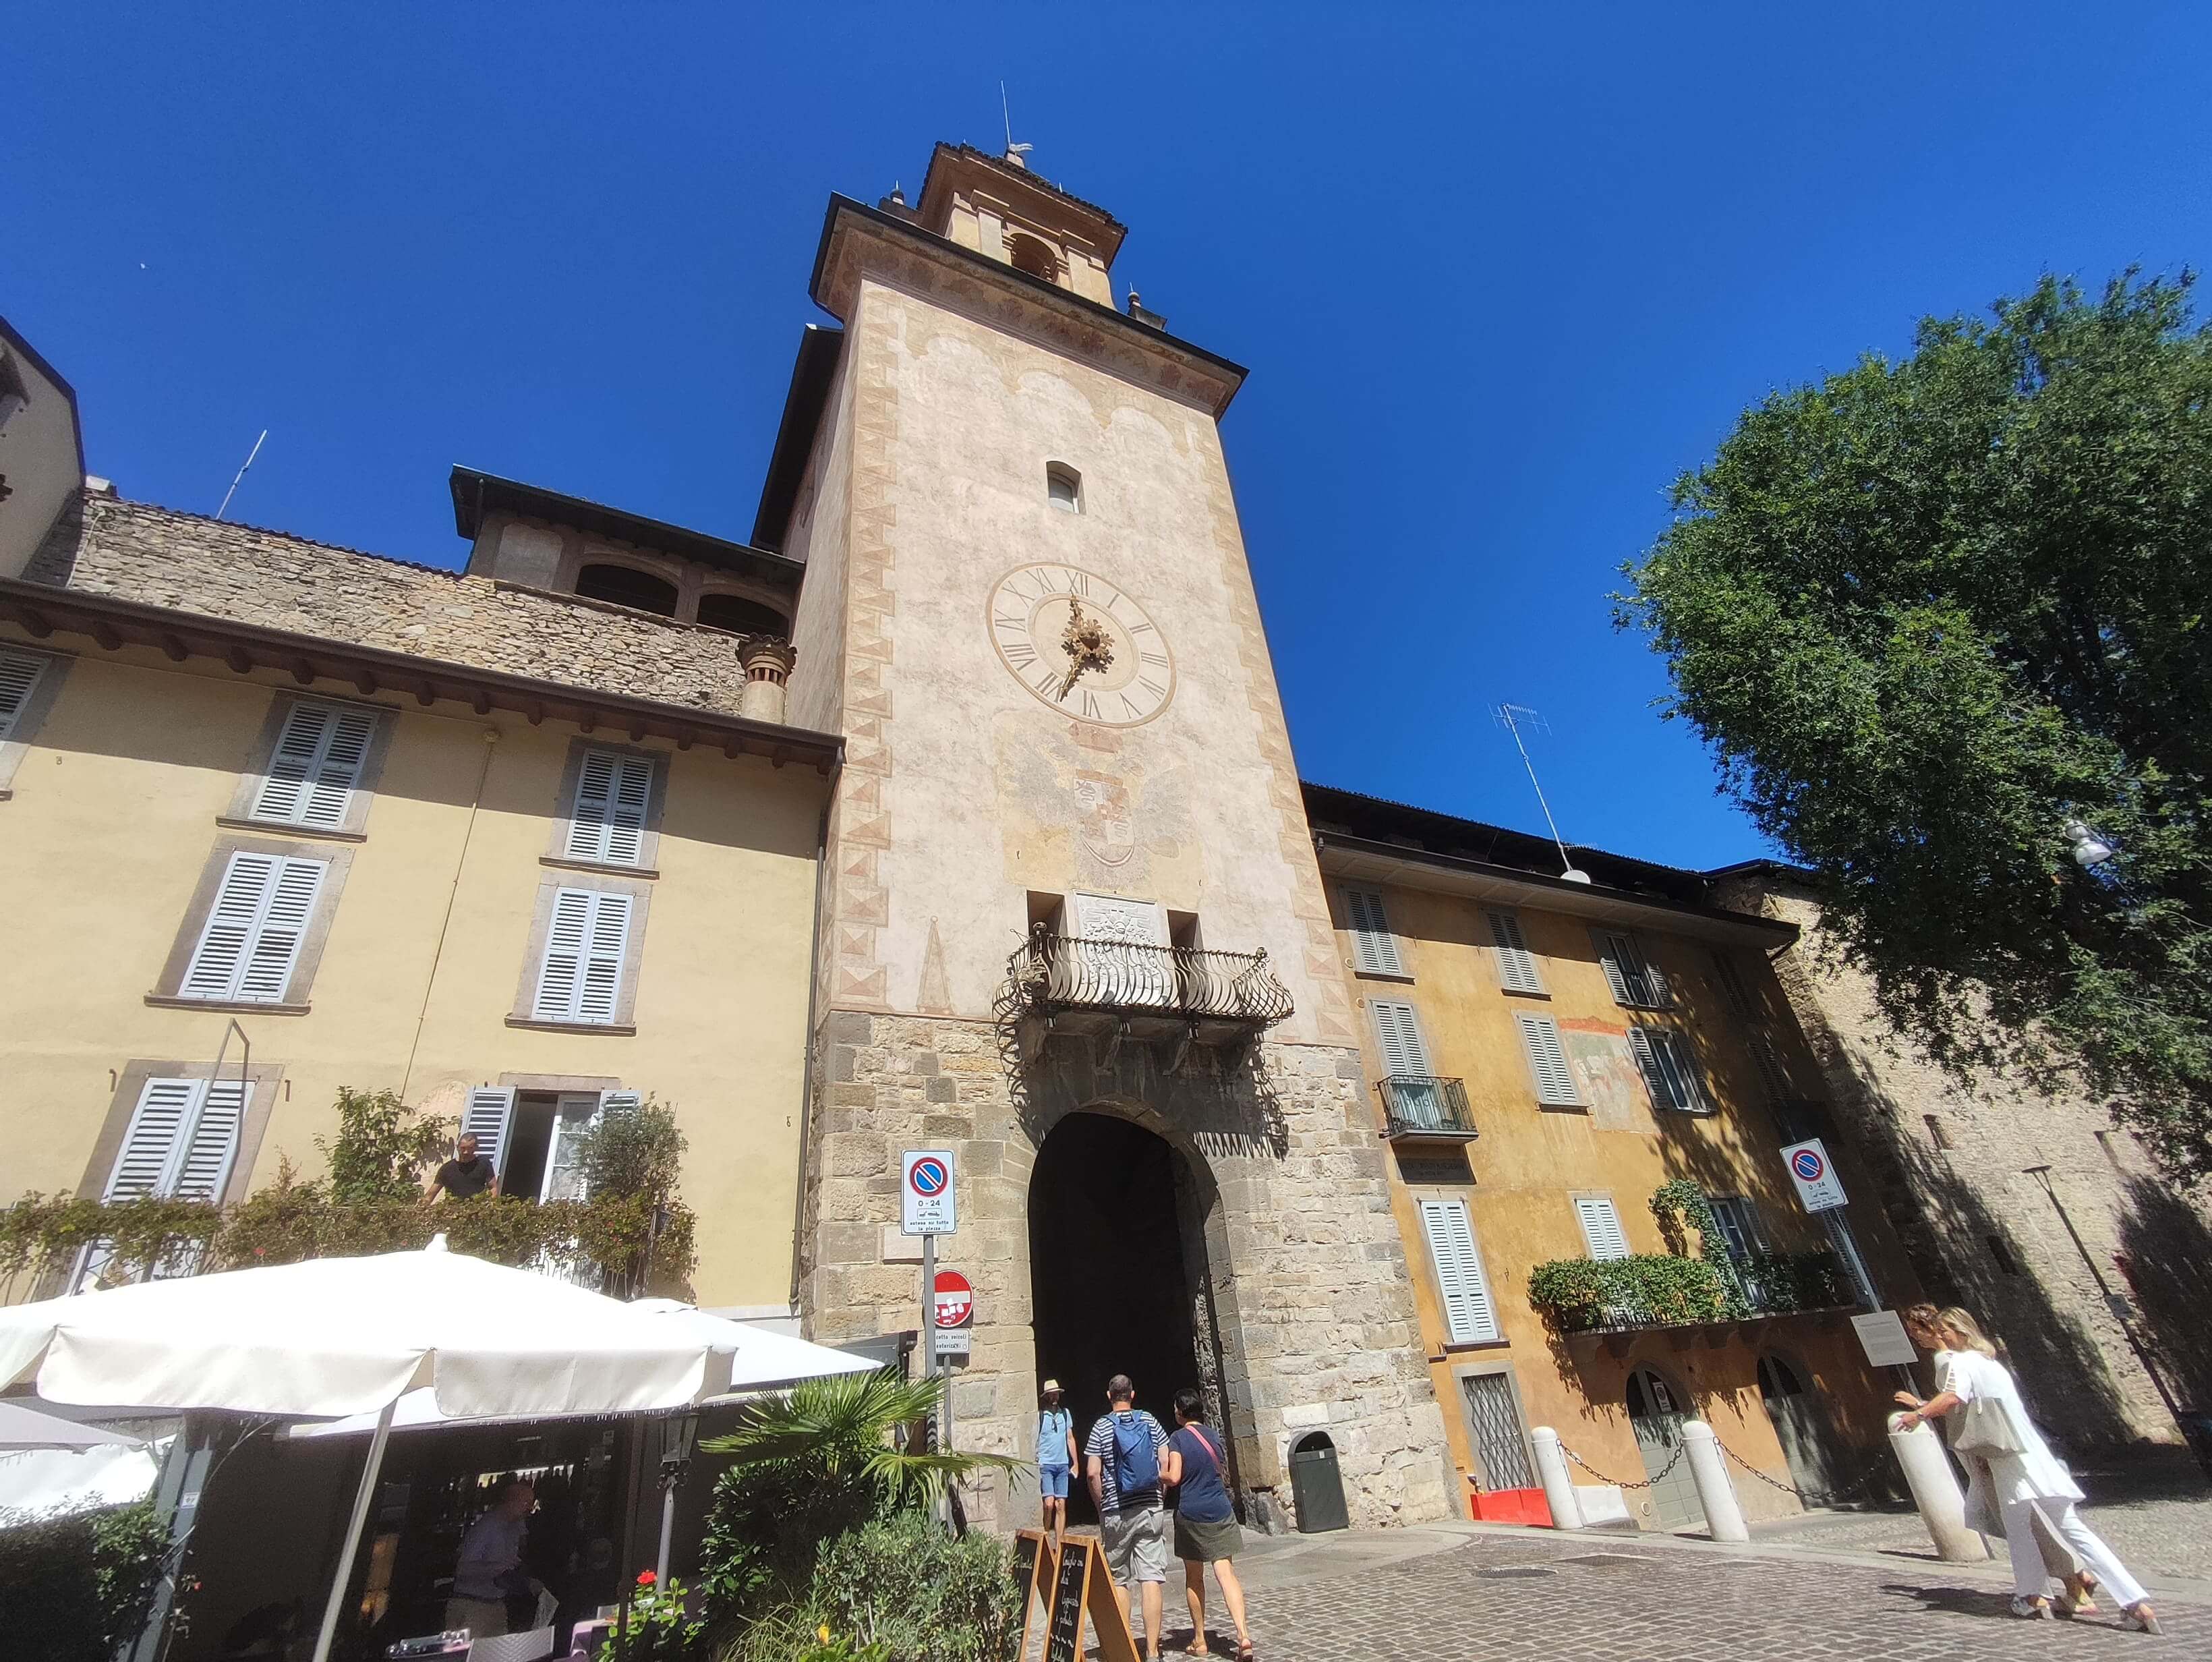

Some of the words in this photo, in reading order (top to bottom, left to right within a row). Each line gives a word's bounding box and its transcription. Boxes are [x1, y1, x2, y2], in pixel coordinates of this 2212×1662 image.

[1001, 579, 1036, 609] X
[1024, 567, 1056, 594] XI
[1064, 569, 1090, 598] XII
[1128, 622, 1153, 634] II
[1002, 643, 1038, 671] VIII
[1140, 652, 1169, 669] III
[1083, 689, 1103, 720] VI
[1119, 691, 1143, 719] V
